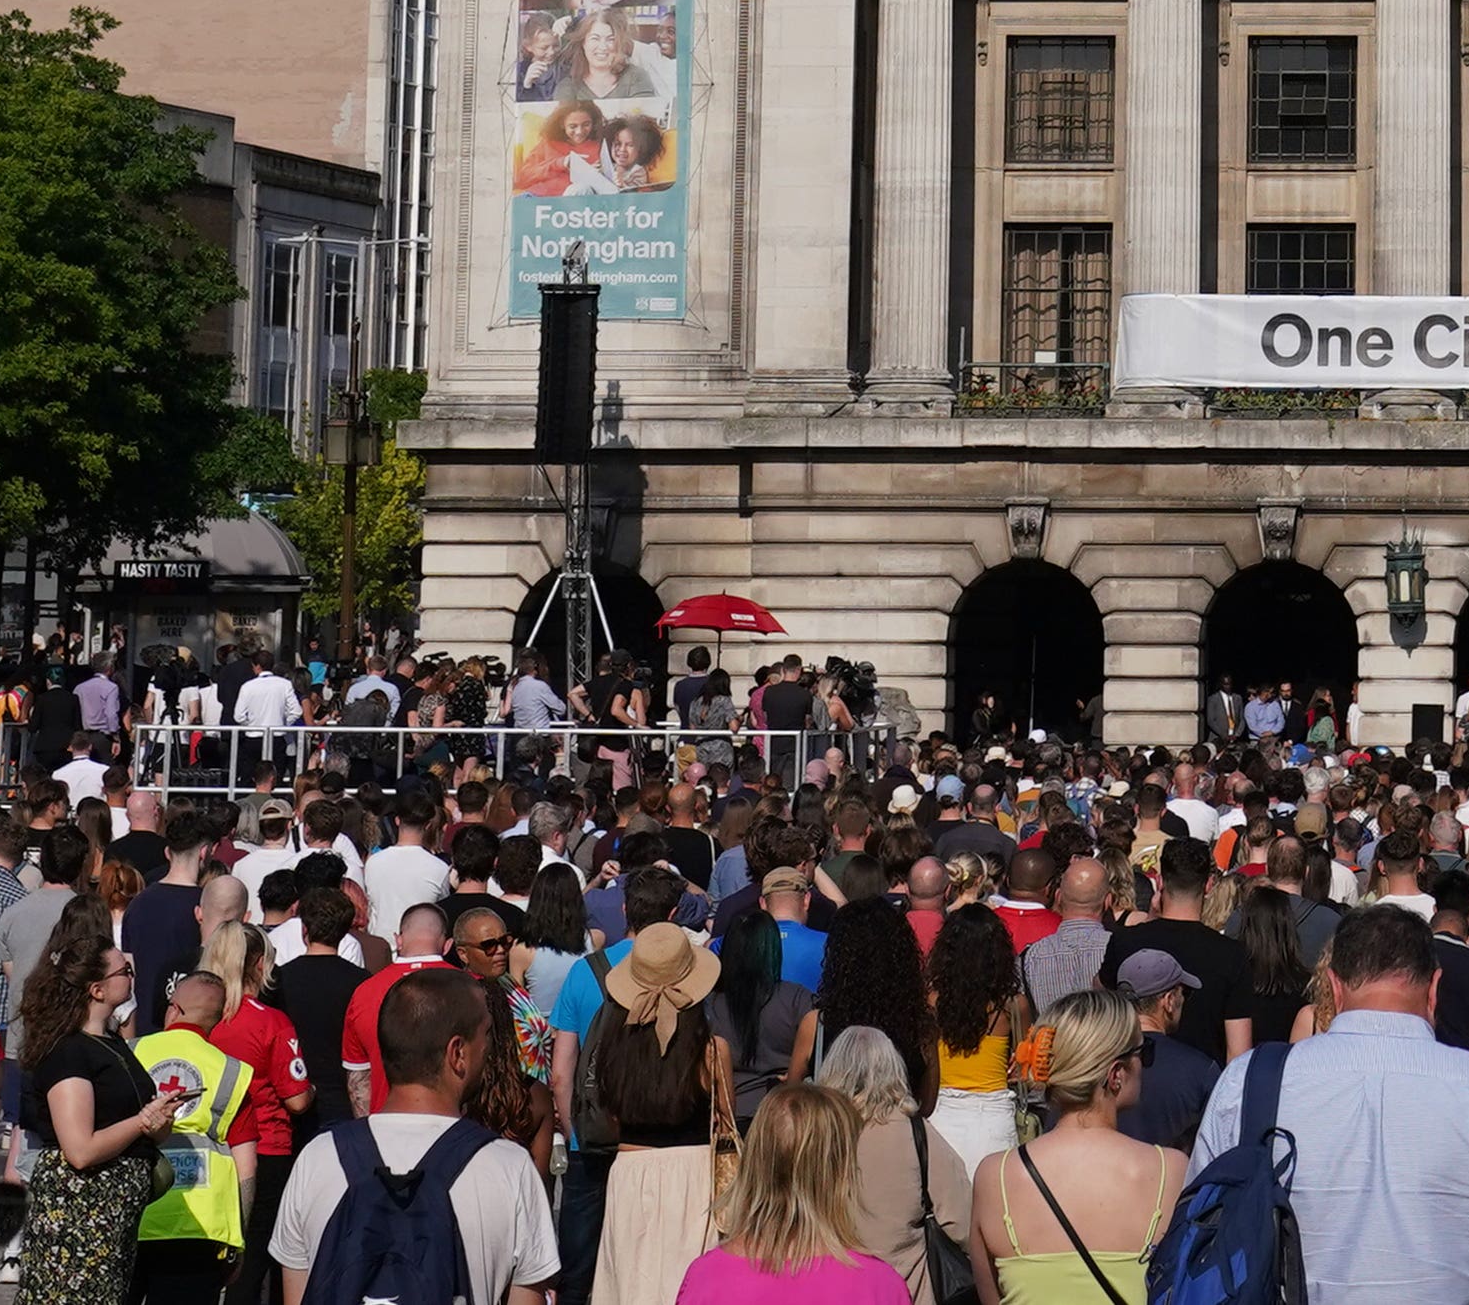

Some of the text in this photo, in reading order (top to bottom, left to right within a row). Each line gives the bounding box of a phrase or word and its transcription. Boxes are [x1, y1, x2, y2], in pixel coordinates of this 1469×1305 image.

[535, 205, 664, 228] Foster for
[521, 235, 676, 264] Notngham
[1261, 313, 1394, 368] One
[120, 563, 201, 578] HASTY TASTY
